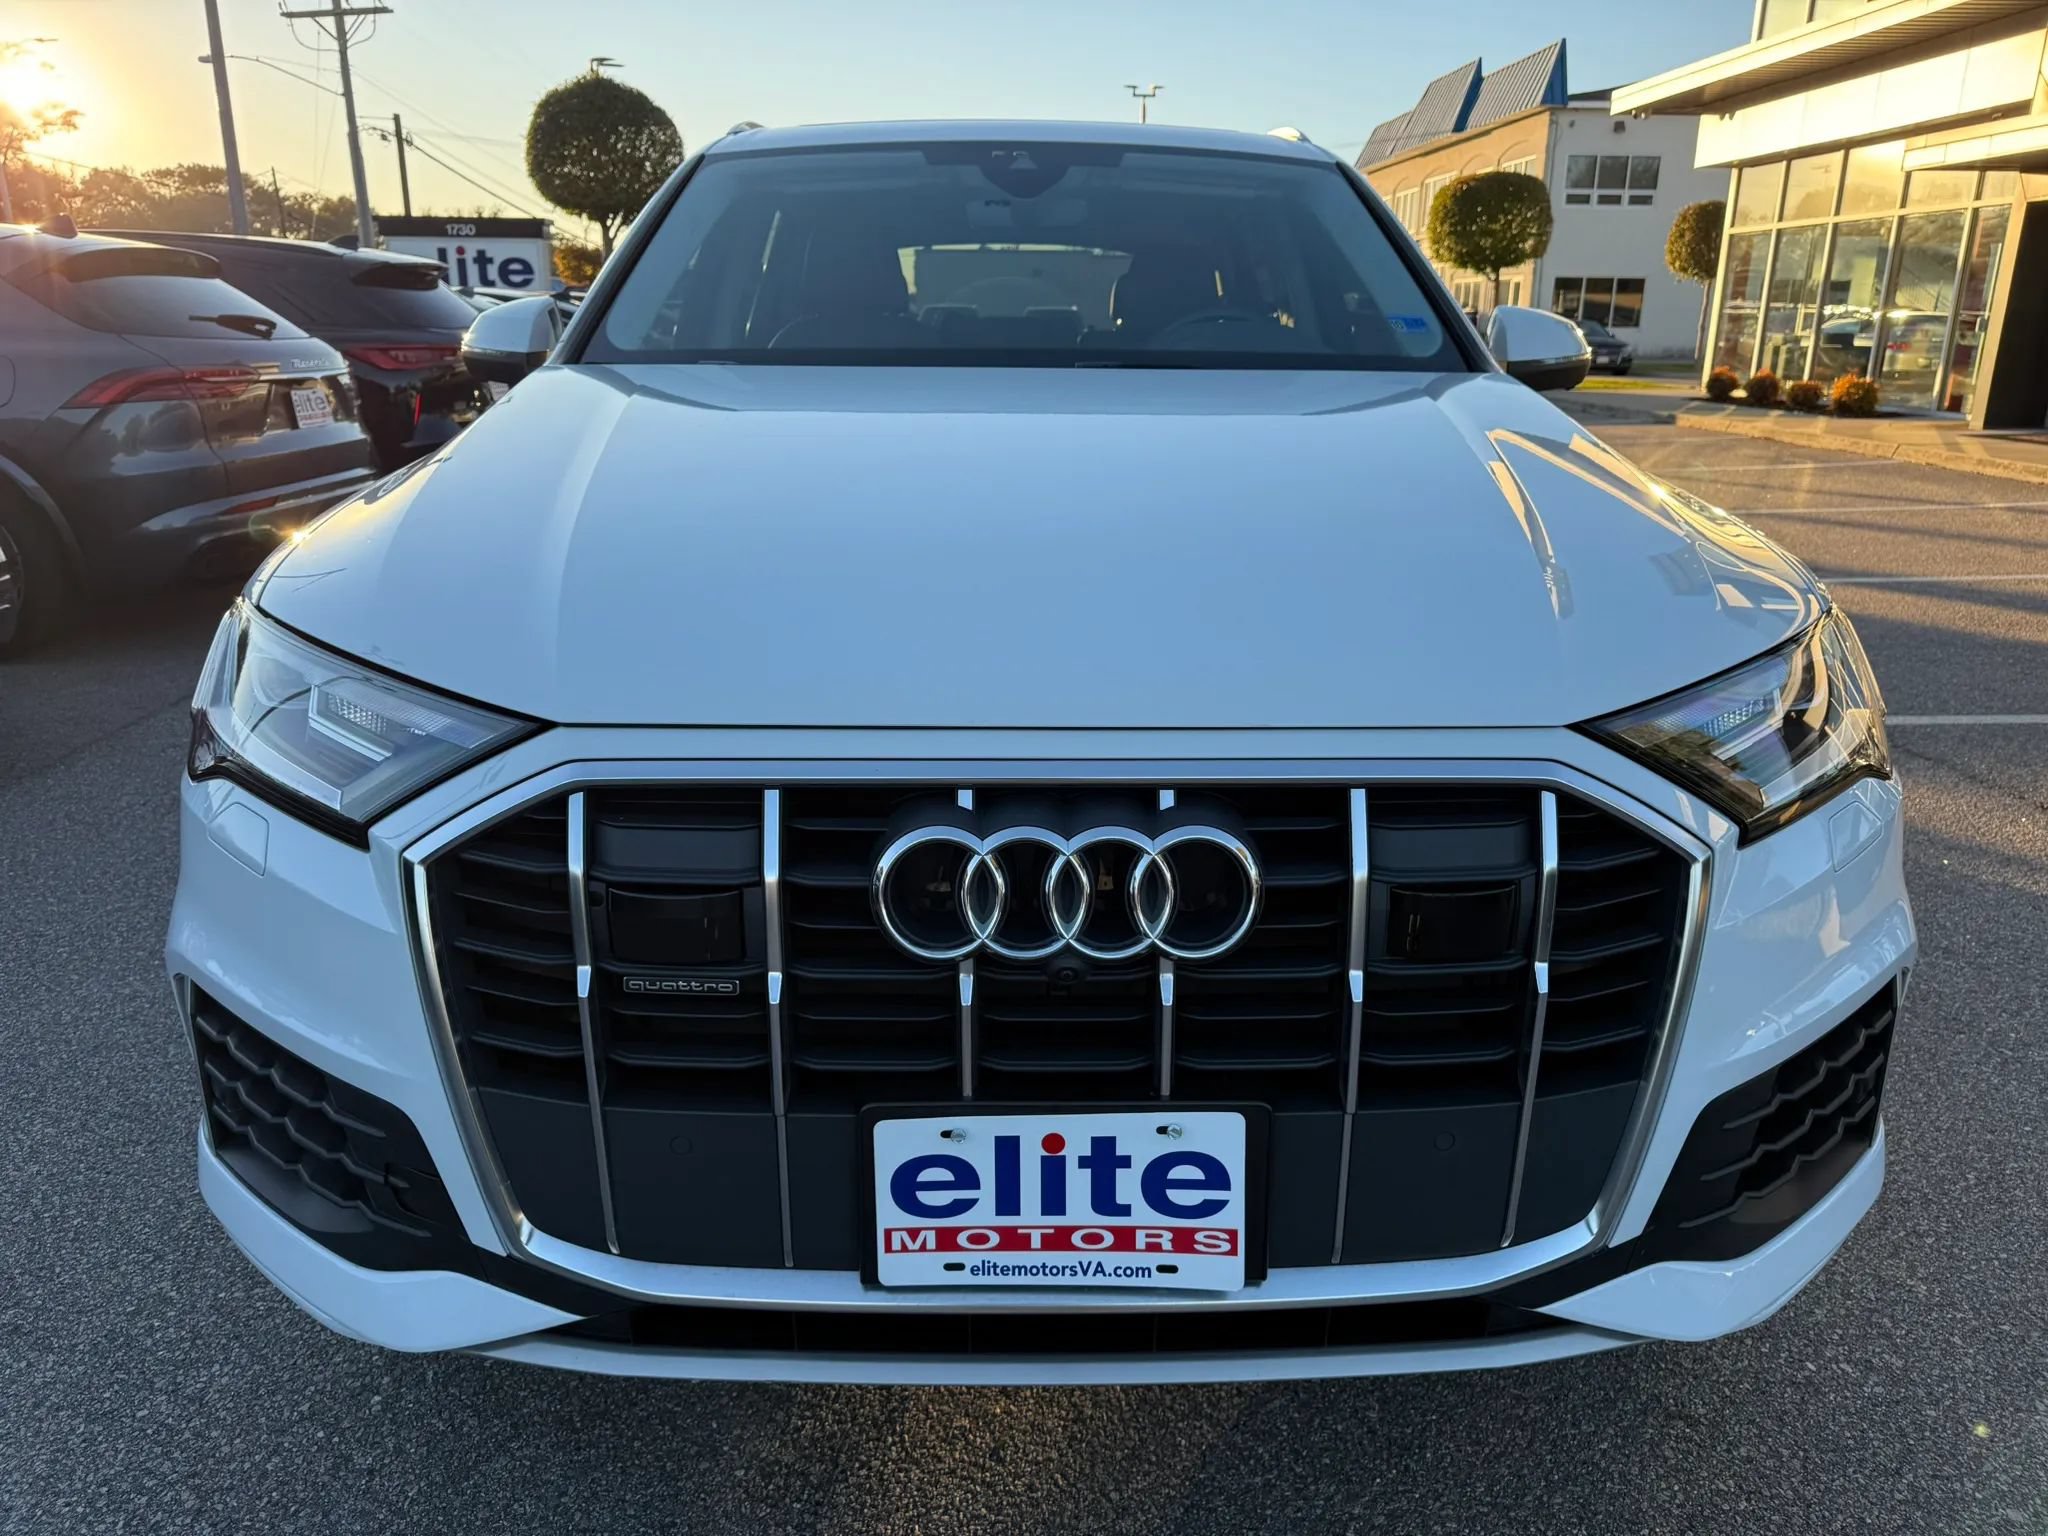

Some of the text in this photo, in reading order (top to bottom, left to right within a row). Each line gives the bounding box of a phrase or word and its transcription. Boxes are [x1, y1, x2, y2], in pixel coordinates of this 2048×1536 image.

[445, 223, 477, 236] 1730
[437, 246, 535, 289] lite
[628, 980, 734, 992] quattro
[889, 1132, 1232, 1220] elite
[890, 1227, 1232, 1254] MOTORS
[969, 1260, 1153, 1279] elitemotorsVA.com
